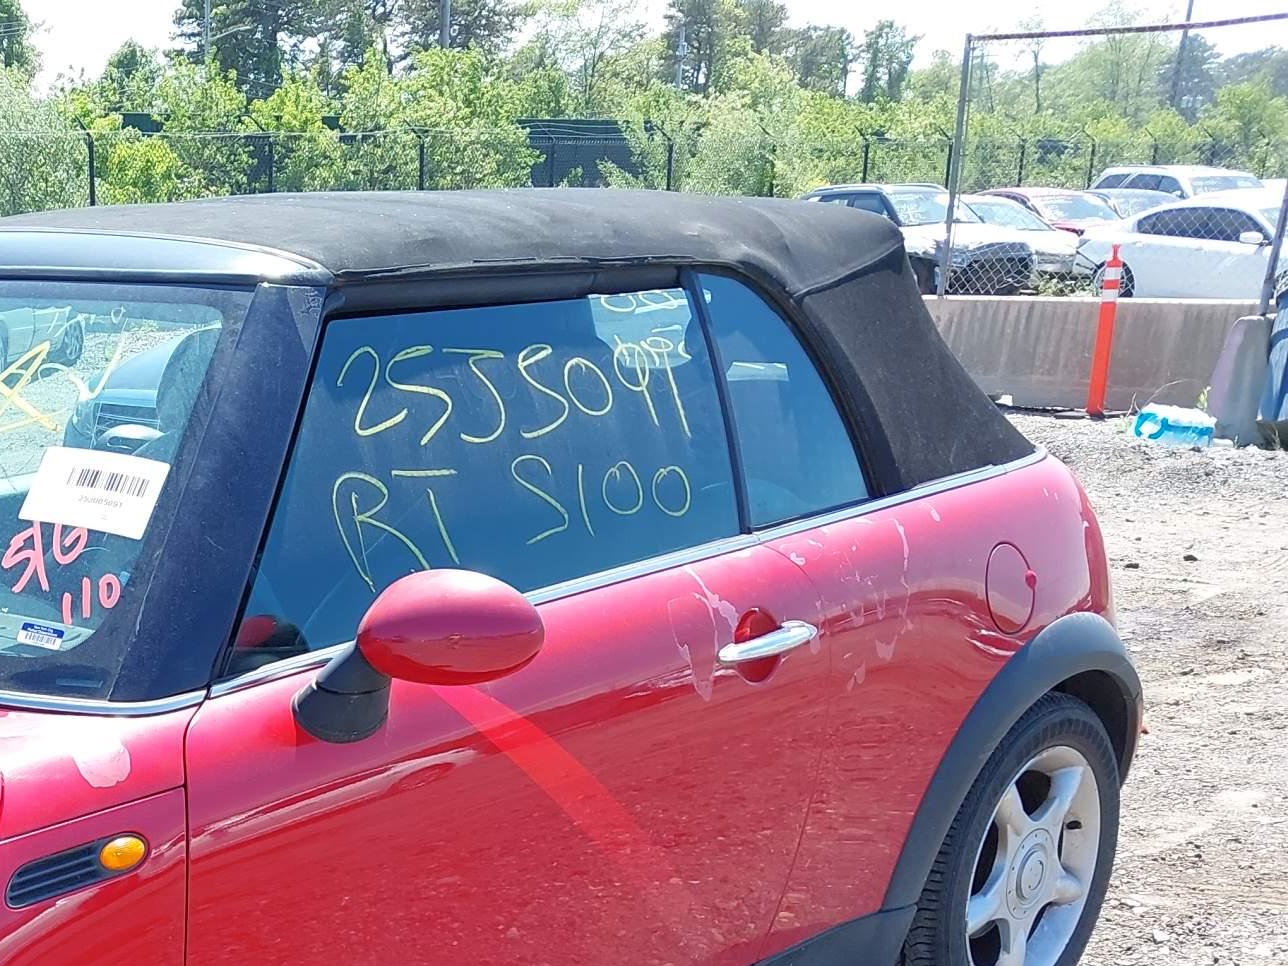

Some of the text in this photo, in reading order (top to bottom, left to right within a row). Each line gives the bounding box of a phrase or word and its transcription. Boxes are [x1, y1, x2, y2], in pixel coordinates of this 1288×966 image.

[332, 454, 691, 593] RT S100
[62, 573, 121, 625] 110
